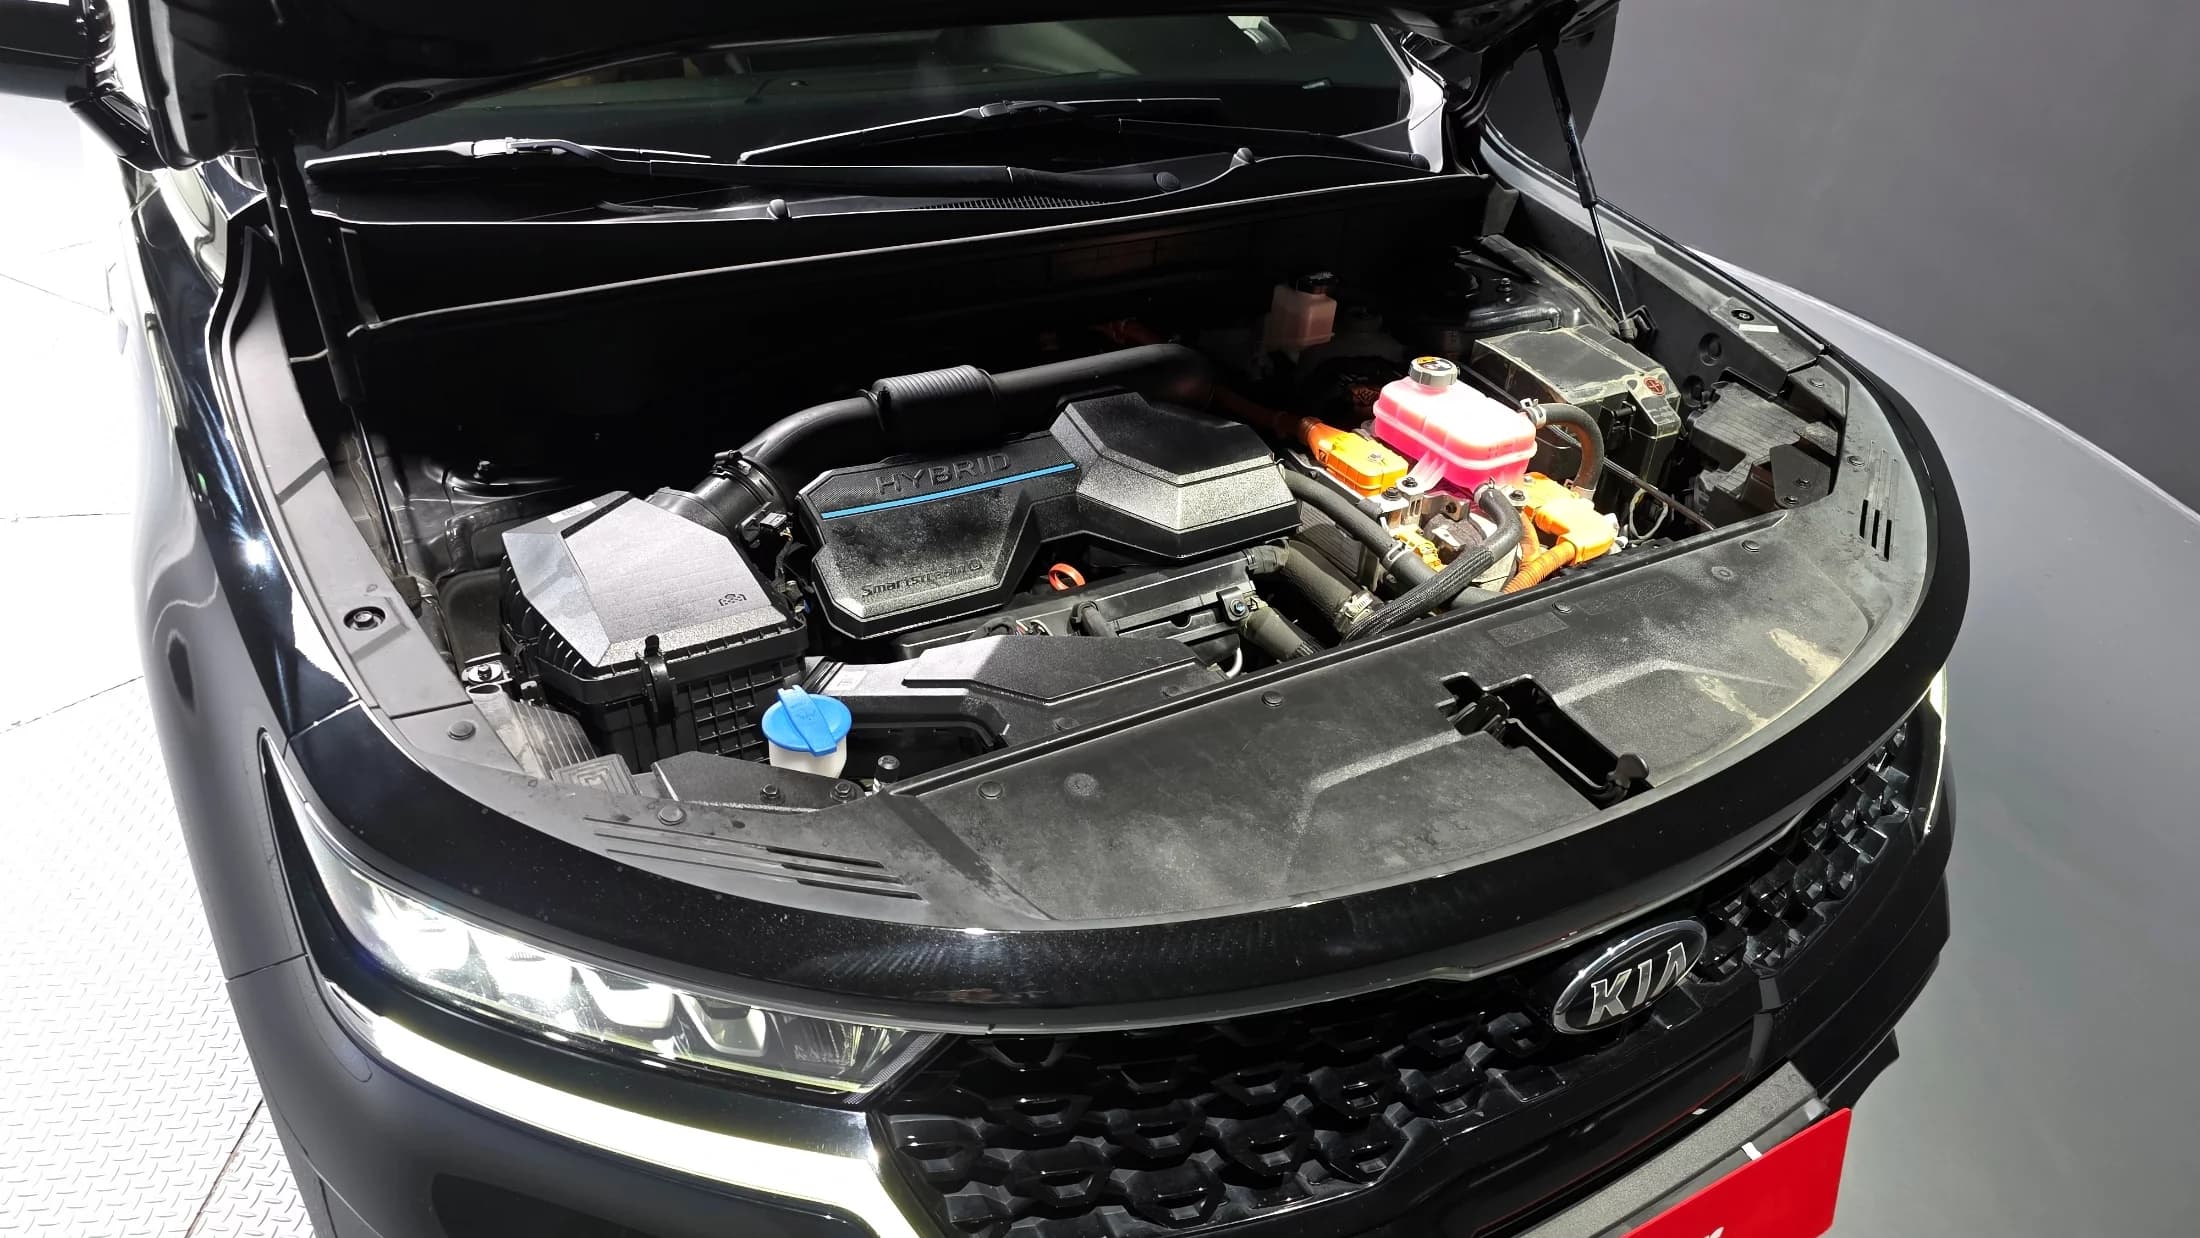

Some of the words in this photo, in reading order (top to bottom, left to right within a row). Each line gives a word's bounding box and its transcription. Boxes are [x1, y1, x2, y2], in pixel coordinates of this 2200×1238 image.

[875, 452, 1010, 495] HYBRID
[861, 564, 967, 598] Smartstream
[1586, 941, 1687, 1026] KIA
